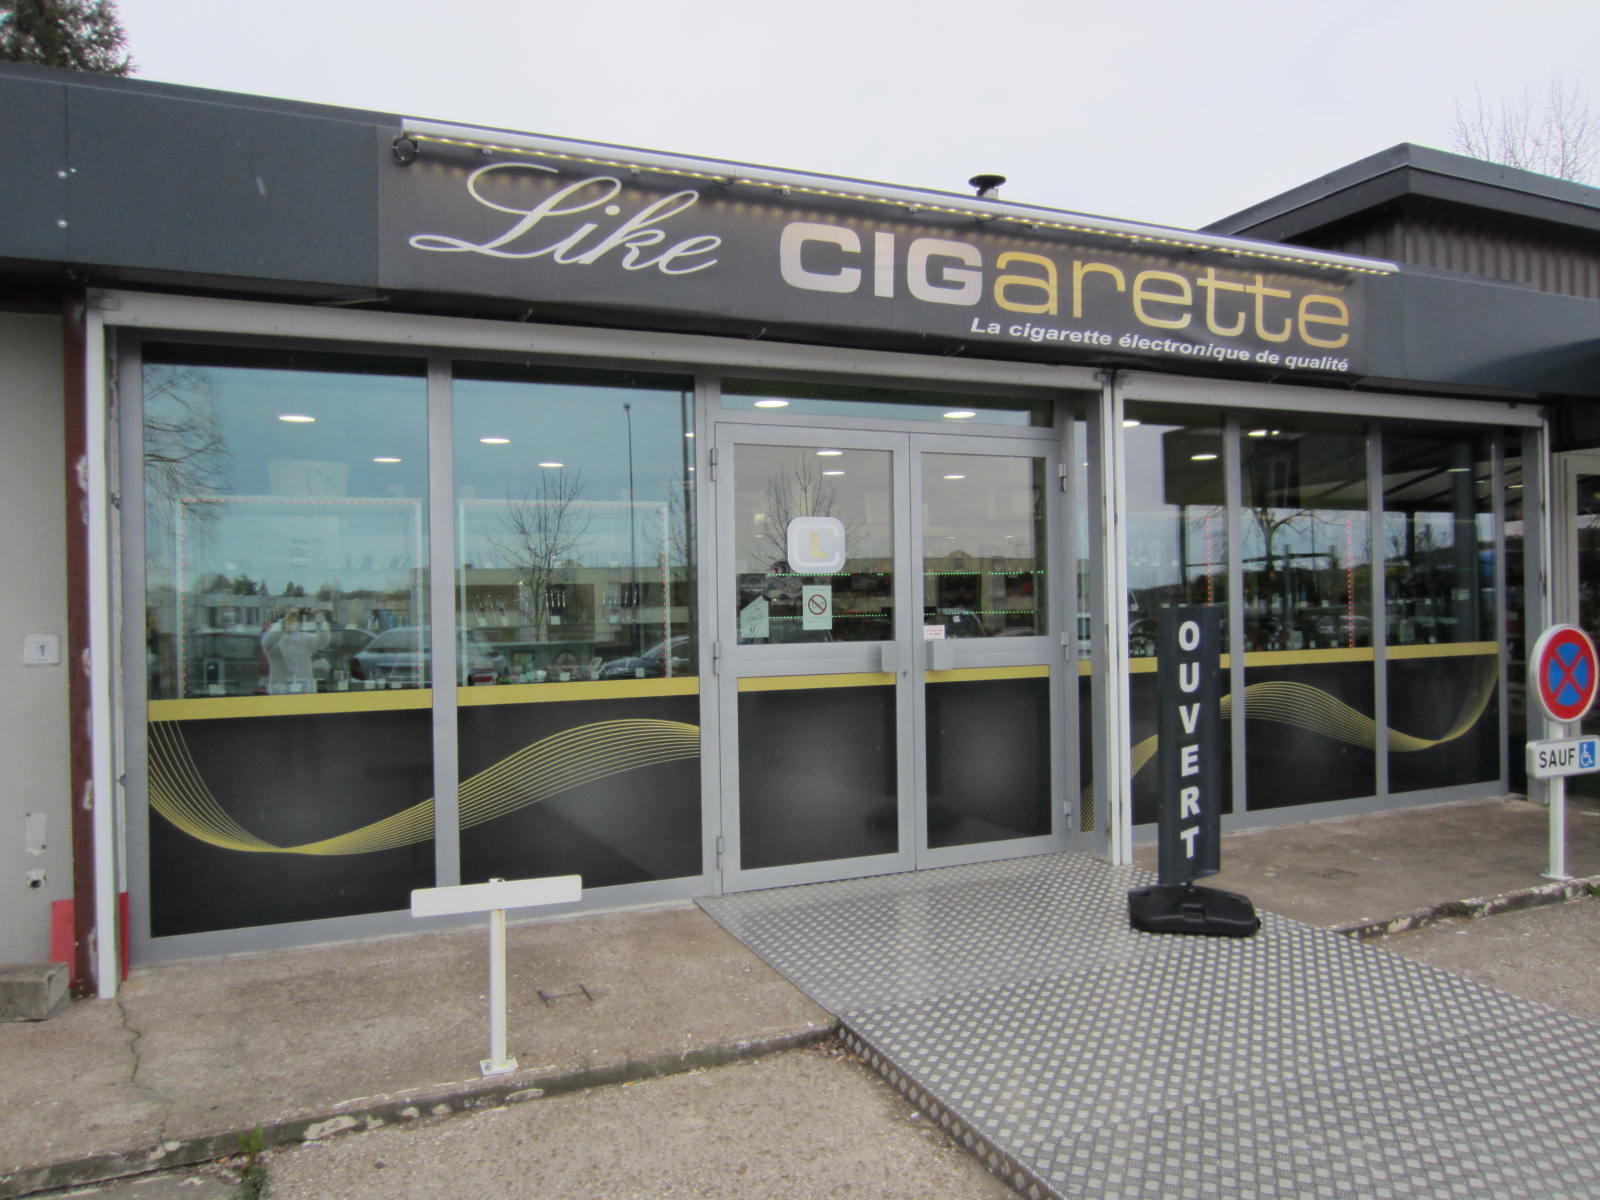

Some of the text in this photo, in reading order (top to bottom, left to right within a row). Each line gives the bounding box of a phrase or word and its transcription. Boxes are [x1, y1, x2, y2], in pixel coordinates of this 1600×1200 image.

[408, 162, 1350, 349] Like CIGarette
[970, 317, 1348, 372] La cigarette électronique de qualité
[810, 531, 827, 559] L
[1178, 620, 1201, 859] OUVERT
[1538, 747, 1576, 769] SAUF
